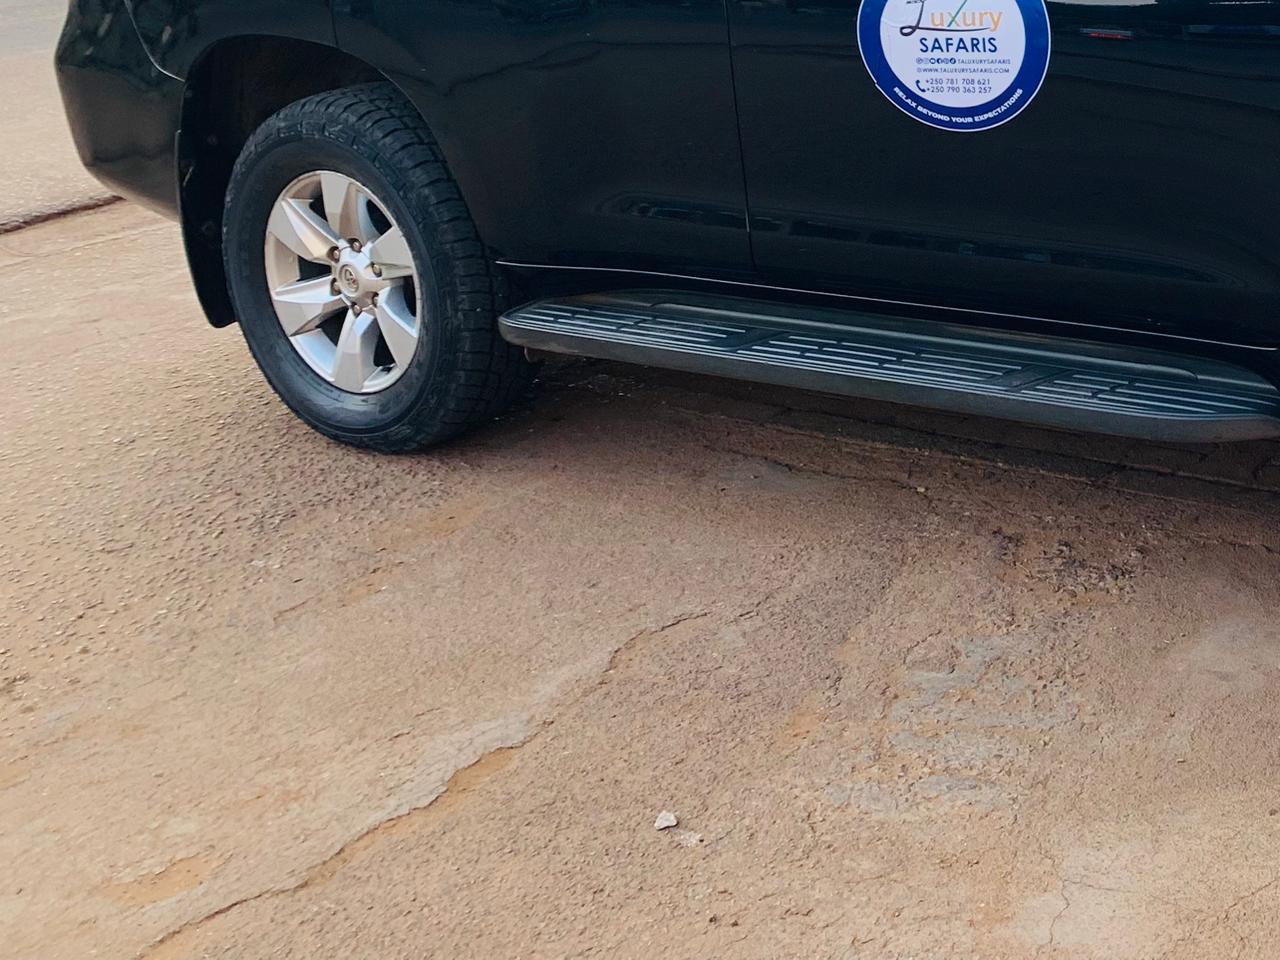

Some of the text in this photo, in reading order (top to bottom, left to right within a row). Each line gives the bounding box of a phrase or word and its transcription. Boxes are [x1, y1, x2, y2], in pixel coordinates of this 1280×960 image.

[900, 0, 1004, 36] Luxury
[919, 37, 998, 53] SAFARIS
[893, 86, 917, 108] RELAX
[916, 105, 950, 121] BEYOND
[974, 88, 1024, 122] EXPECTATIONS
